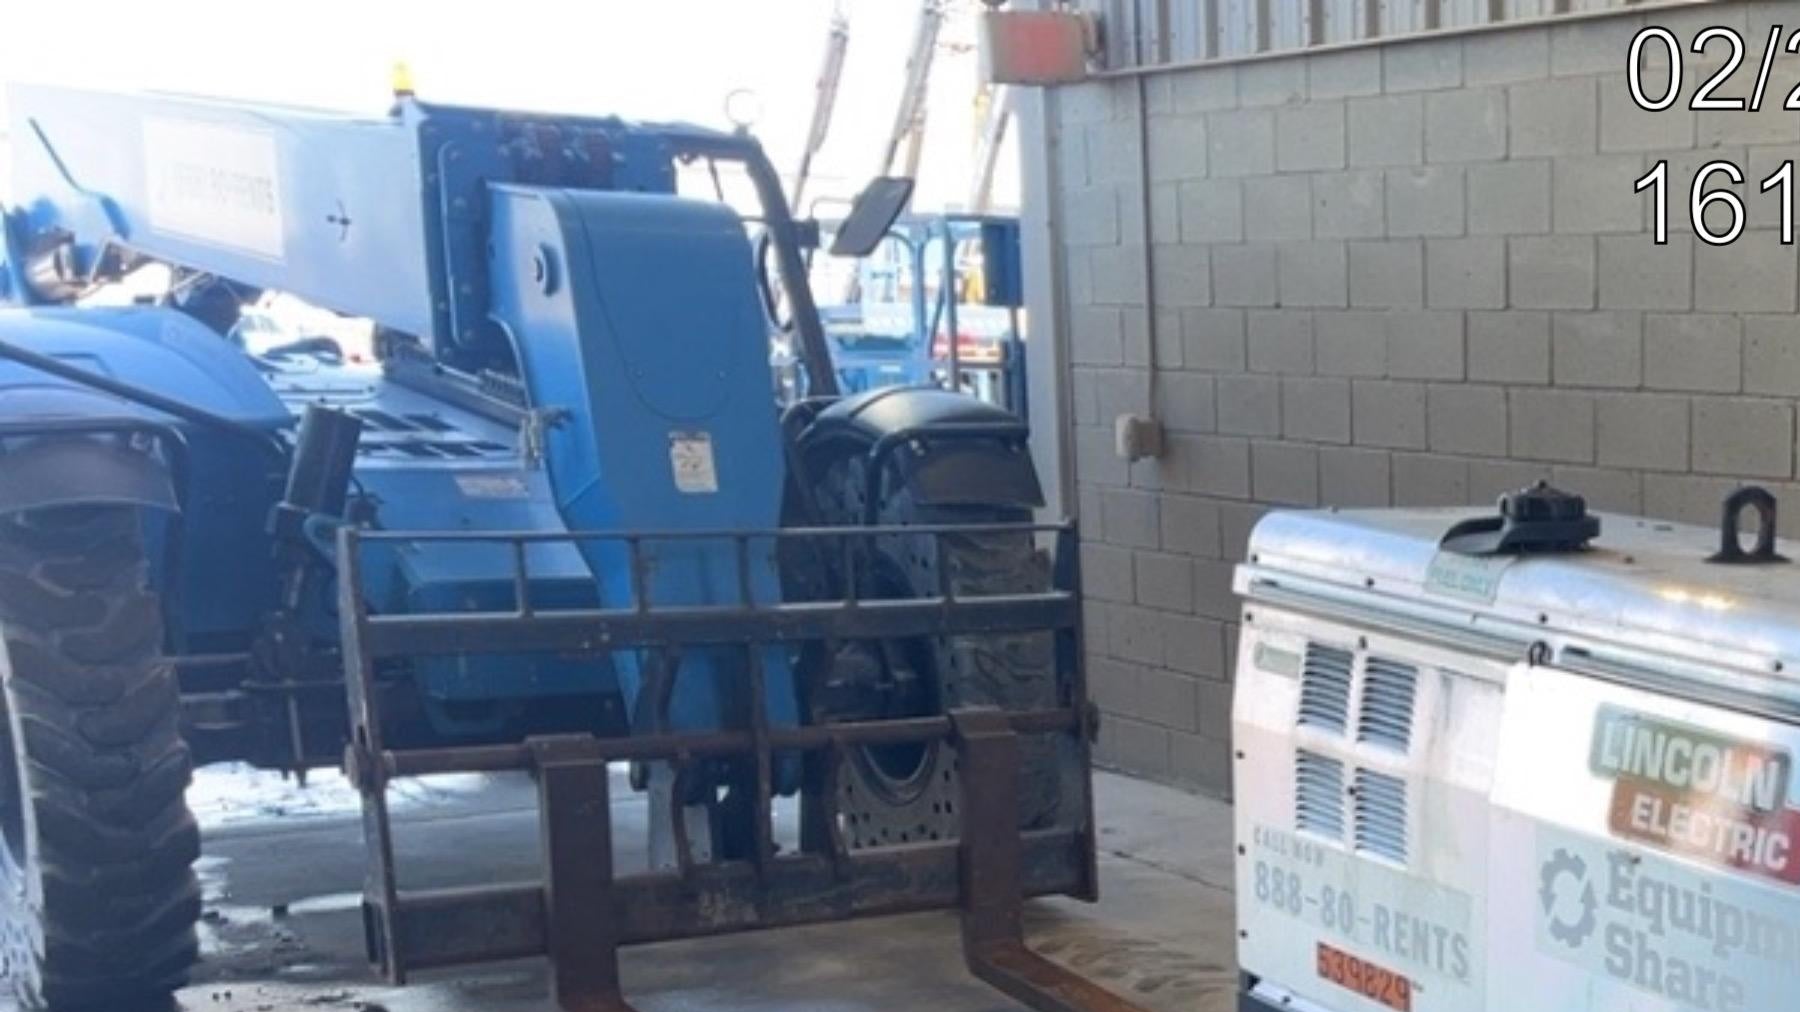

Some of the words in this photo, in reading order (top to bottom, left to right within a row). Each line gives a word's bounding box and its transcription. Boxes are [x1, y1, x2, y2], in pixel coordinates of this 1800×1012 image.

[1600, 718, 1780, 812] LINCOLN
[1631, 793, 1789, 872] ELECTRIC
[1254, 860, 1470, 980] 888-80-RENTS
